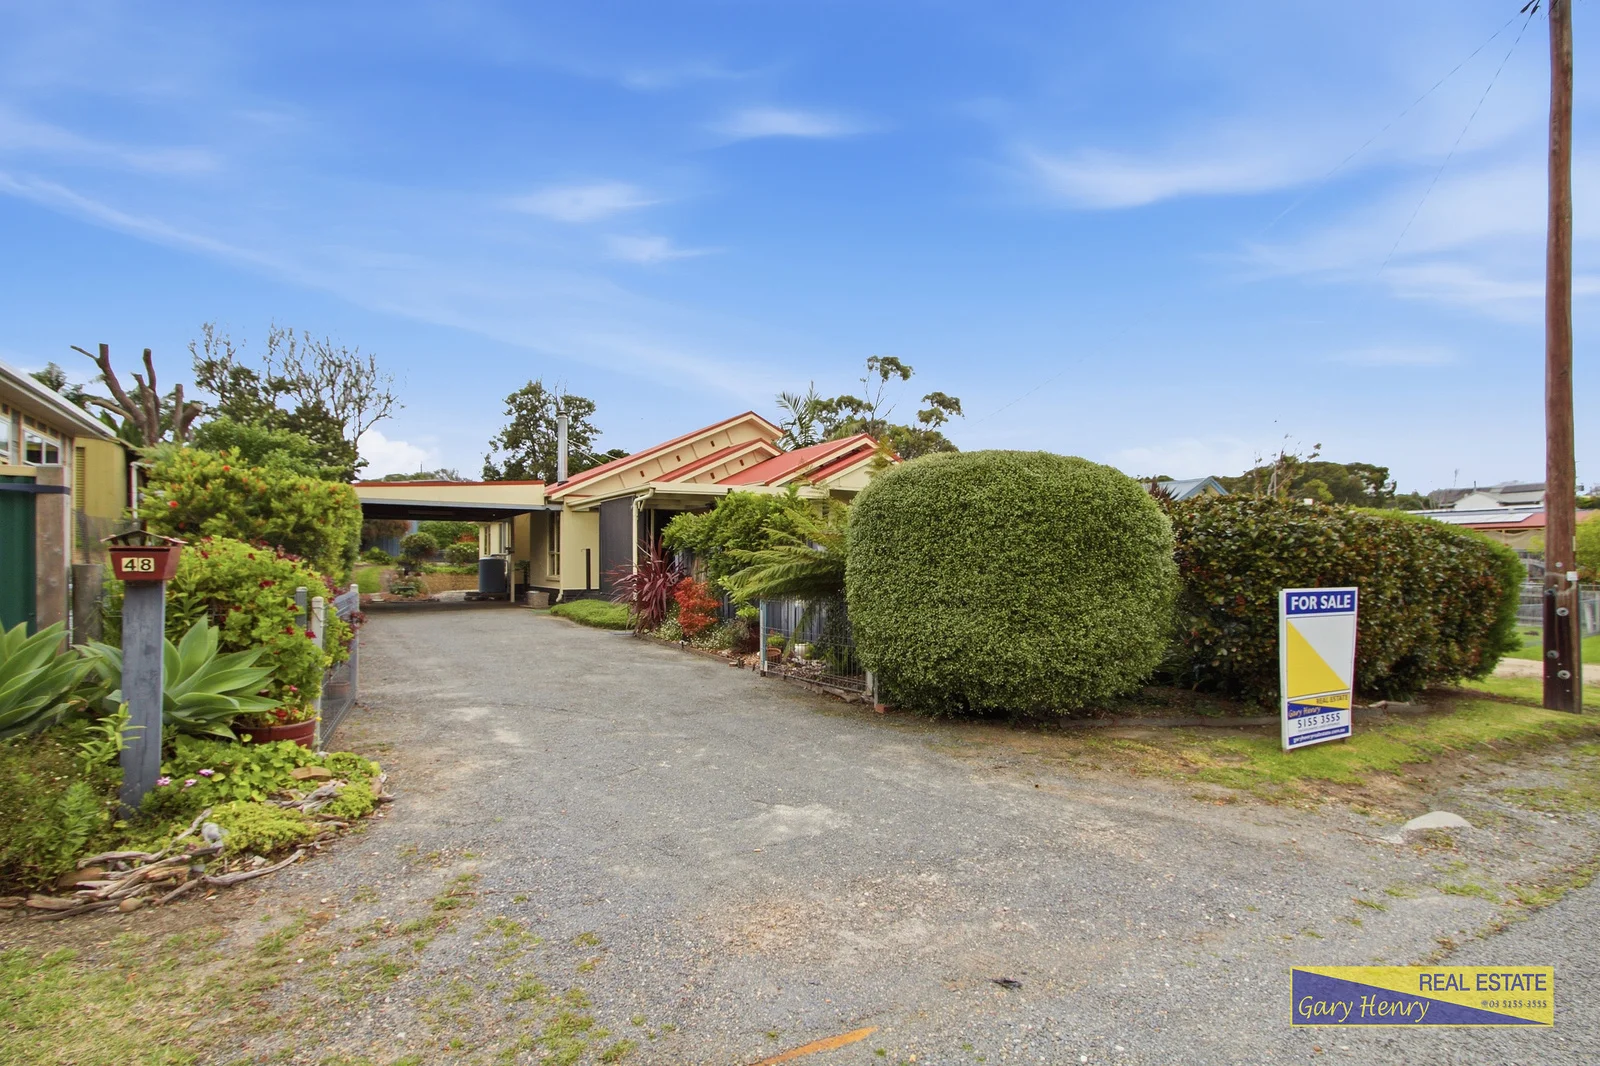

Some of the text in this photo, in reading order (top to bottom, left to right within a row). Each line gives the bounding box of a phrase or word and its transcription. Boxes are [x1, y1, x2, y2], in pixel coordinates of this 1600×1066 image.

[123, 558, 153, 571] 48
[1291, 594, 1351, 611] FOR SALE
[1316, 694, 1348, 705] REAL ESTATE
[1297, 716, 1318, 729] 5155
[1320, 712, 1341, 724] 3555
